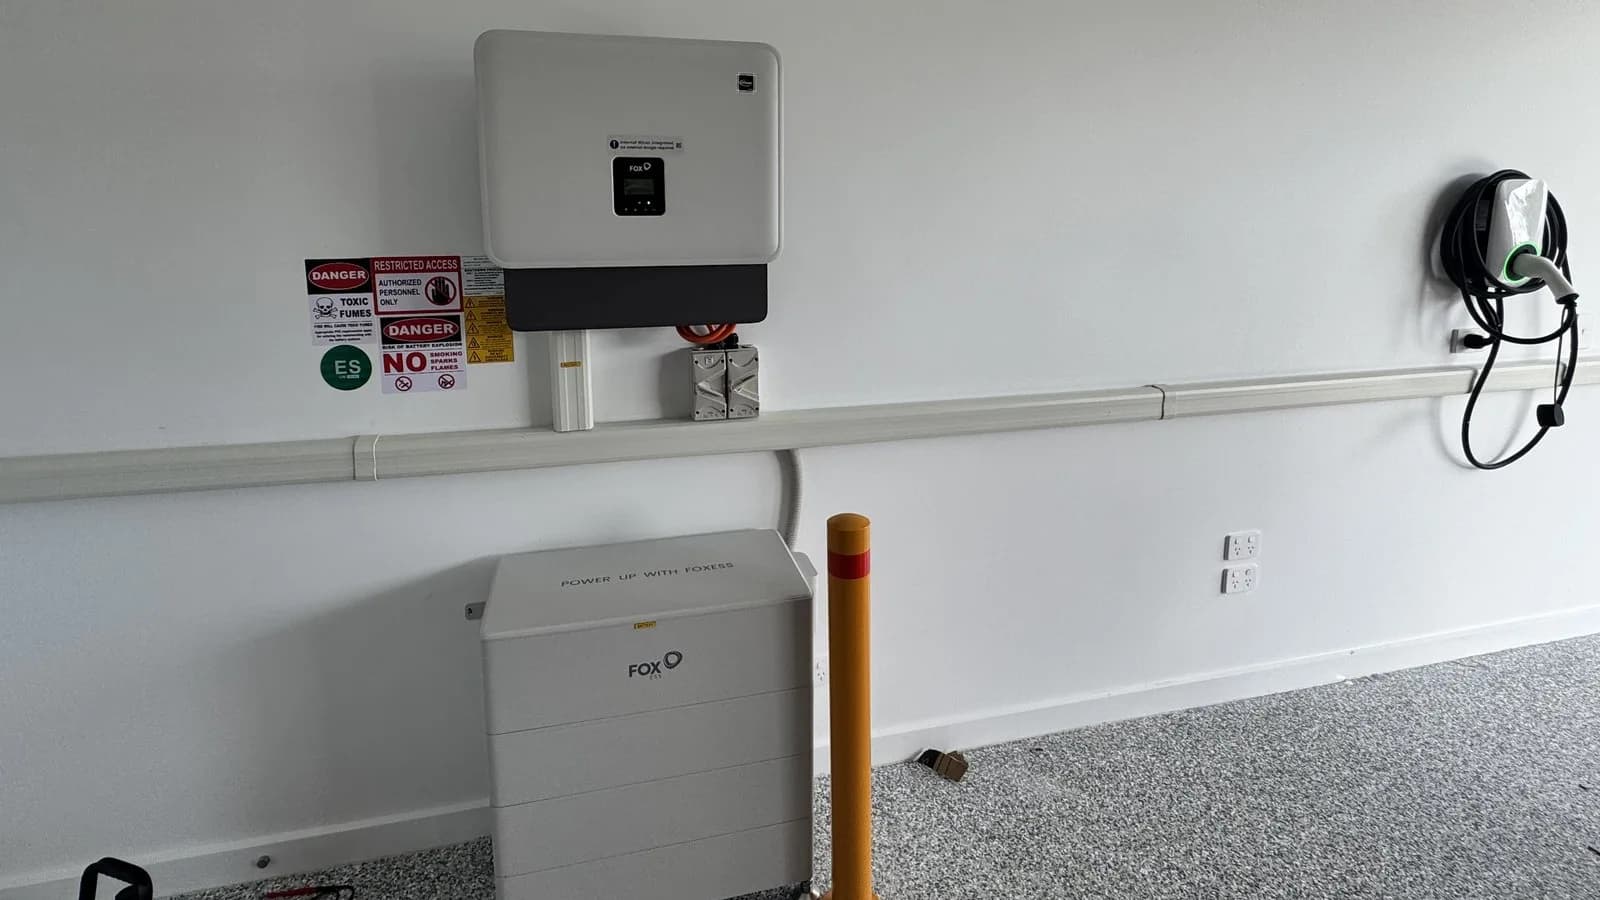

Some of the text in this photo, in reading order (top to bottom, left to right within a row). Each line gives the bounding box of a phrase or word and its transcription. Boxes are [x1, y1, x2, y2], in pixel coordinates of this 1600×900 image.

[374, 260, 425, 271] RESTRICTED
[426, 259, 458, 270] ACCESS
[312, 270, 366, 281] DANGER
[378, 278, 422, 287] AUTHORIZED
[379, 288, 420, 296] PERSONNEL
[340, 297, 369, 306] TOXIC
[380, 298, 398, 306] ONLY
[339, 309, 372, 318] FUMES
[389, 324, 454, 336] DANGER
[334, 359, 361, 375] ES
[383, 352, 427, 373] NO
[561, 562, 734, 587] POWER UP WITH FOXESS
[628, 661, 662, 678] FOX
